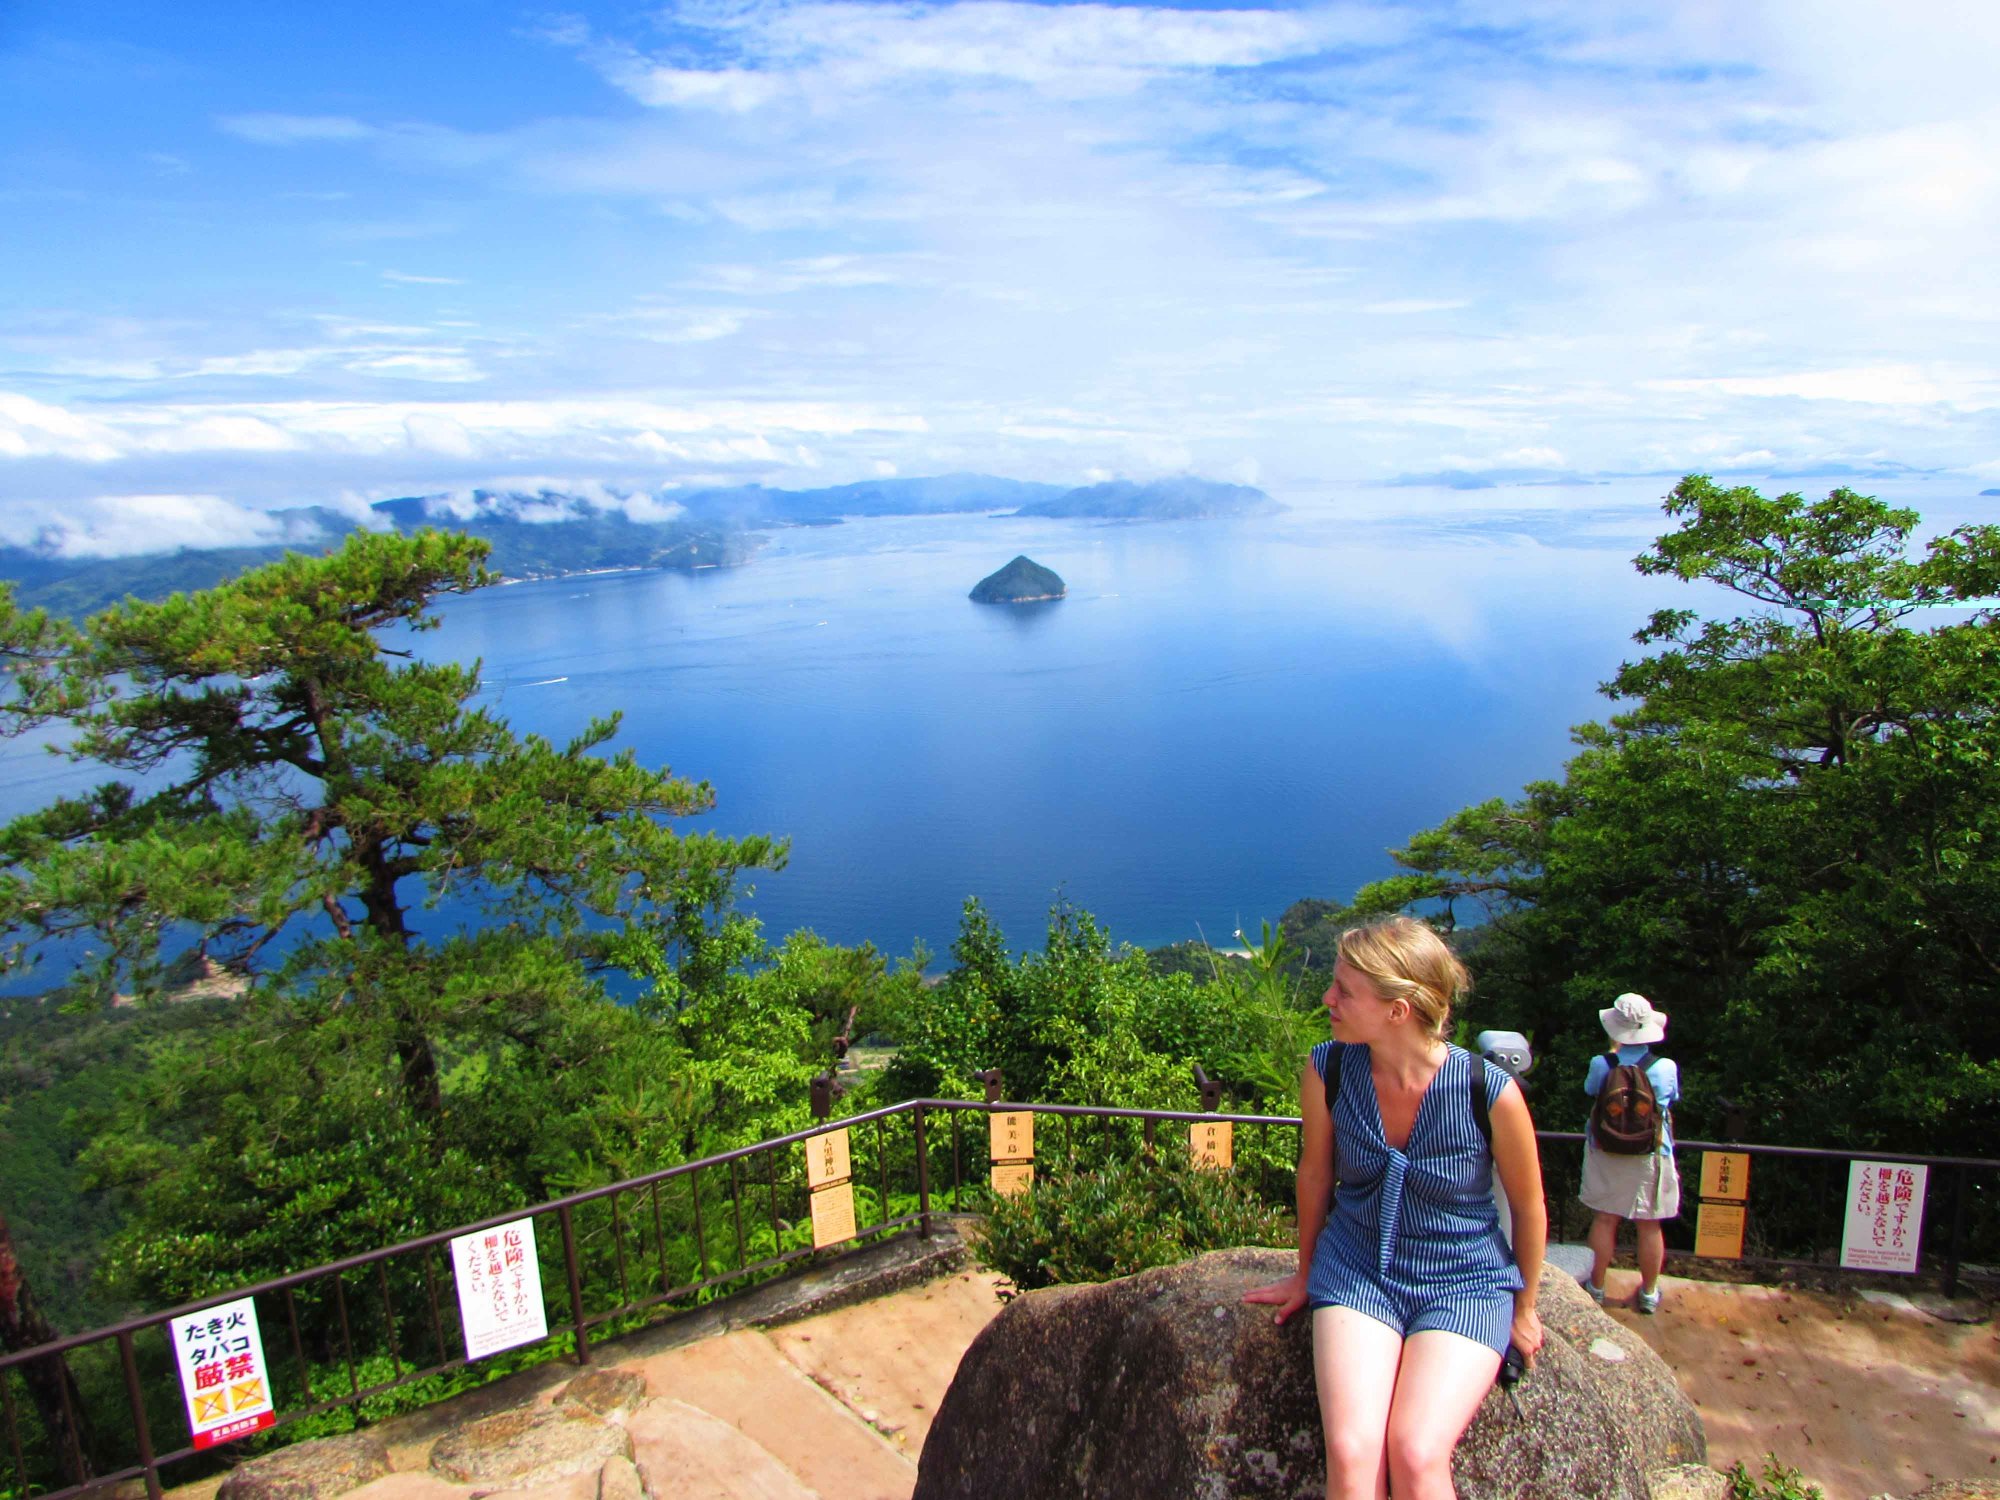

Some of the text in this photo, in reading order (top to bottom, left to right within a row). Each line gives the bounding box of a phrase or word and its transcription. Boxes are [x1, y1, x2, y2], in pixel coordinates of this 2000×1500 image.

[1007, 1116, 1017, 1153] 能美島
[823, 1137, 835, 1177] 大黒神島
[1718, 1155, 1730, 1194] 小黒神島
[1857, 1166, 1873, 1216] ください。
[1872, 1167, 1892, 1247] 柵を越えないで
[1891, 1168, 1914, 1248] 危険ですから
[484, 1234, 508, 1322] 柵を越えないで
[503, 1230, 529, 1316] 危険ですから
[185, 1312, 246, 1342] たき火
[190, 1335, 250, 1365] タバコ
[194, 1352, 255, 1390] 厳禁
